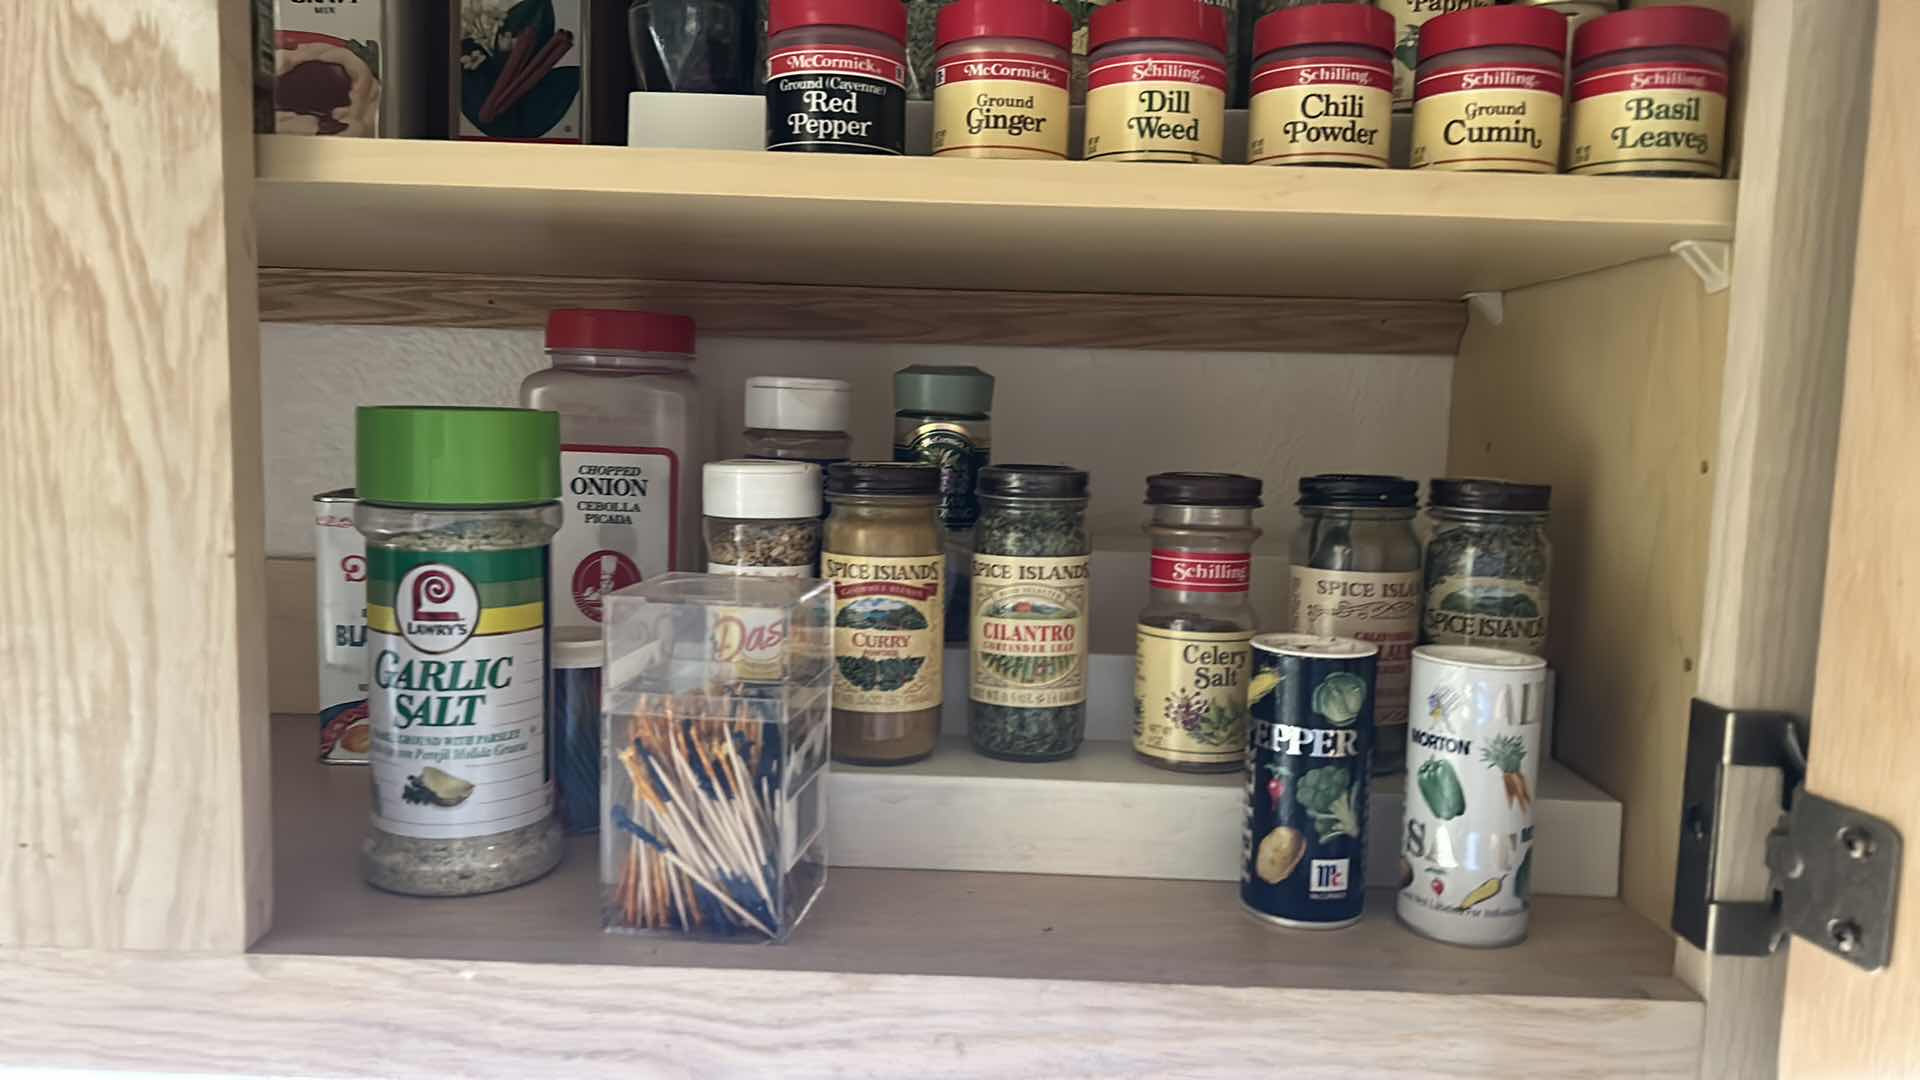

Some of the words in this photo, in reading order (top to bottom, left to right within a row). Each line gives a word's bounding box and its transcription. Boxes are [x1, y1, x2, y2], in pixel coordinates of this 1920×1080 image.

[785, 53, 877, 73] McCormick
[964, 63, 1054, 81] McCormick
[1132, 60, 1201, 81] Schilling
[779, 77, 823, 92] Ground
[1299, 67, 1369, 85] Schilling
[1461, 71, 1537, 88] Schilling
[802, 90, 859, 114] Red
[976, 93, 1034, 109] Ground
[1139, 90, 1191, 113] Dill
[1300, 93, 1364, 119] Chili
[1464, 101, 1526, 119] Ground
[1625, 97, 1700, 121] Basil
[786, 113, 872, 139] Pepper
[966, 107, 1047, 136] Ginger
[1127, 116, 1200, 141] Weed
[1283, 120, 1379, 145] Powder
[1443, 119, 1543, 149] Cumin
[1611, 126, 1708, 154] Leaves
[579, 465, 641, 476] CHOPPED
[571, 477, 648, 496] ONION
[577, 501, 641, 512] CEBOLLA
[827, 559, 871, 579] SPICE
[874, 562, 938, 580] ISLANDS
[1316, 579, 1376, 597] SPICE
[407, 622, 468, 635] LAWRY'S
[983, 622, 1076, 642] CILANTRO
[852, 632, 912, 648] CURRY
[1182, 644, 1248, 669] Celery
[375, 649, 514, 691] GARLIC
[1195, 667, 1238, 689] Salt
[394, 693, 487, 729] SALT
[1253, 720, 1359, 757] EPPER
[1411, 728, 1472, 756] MORTON
